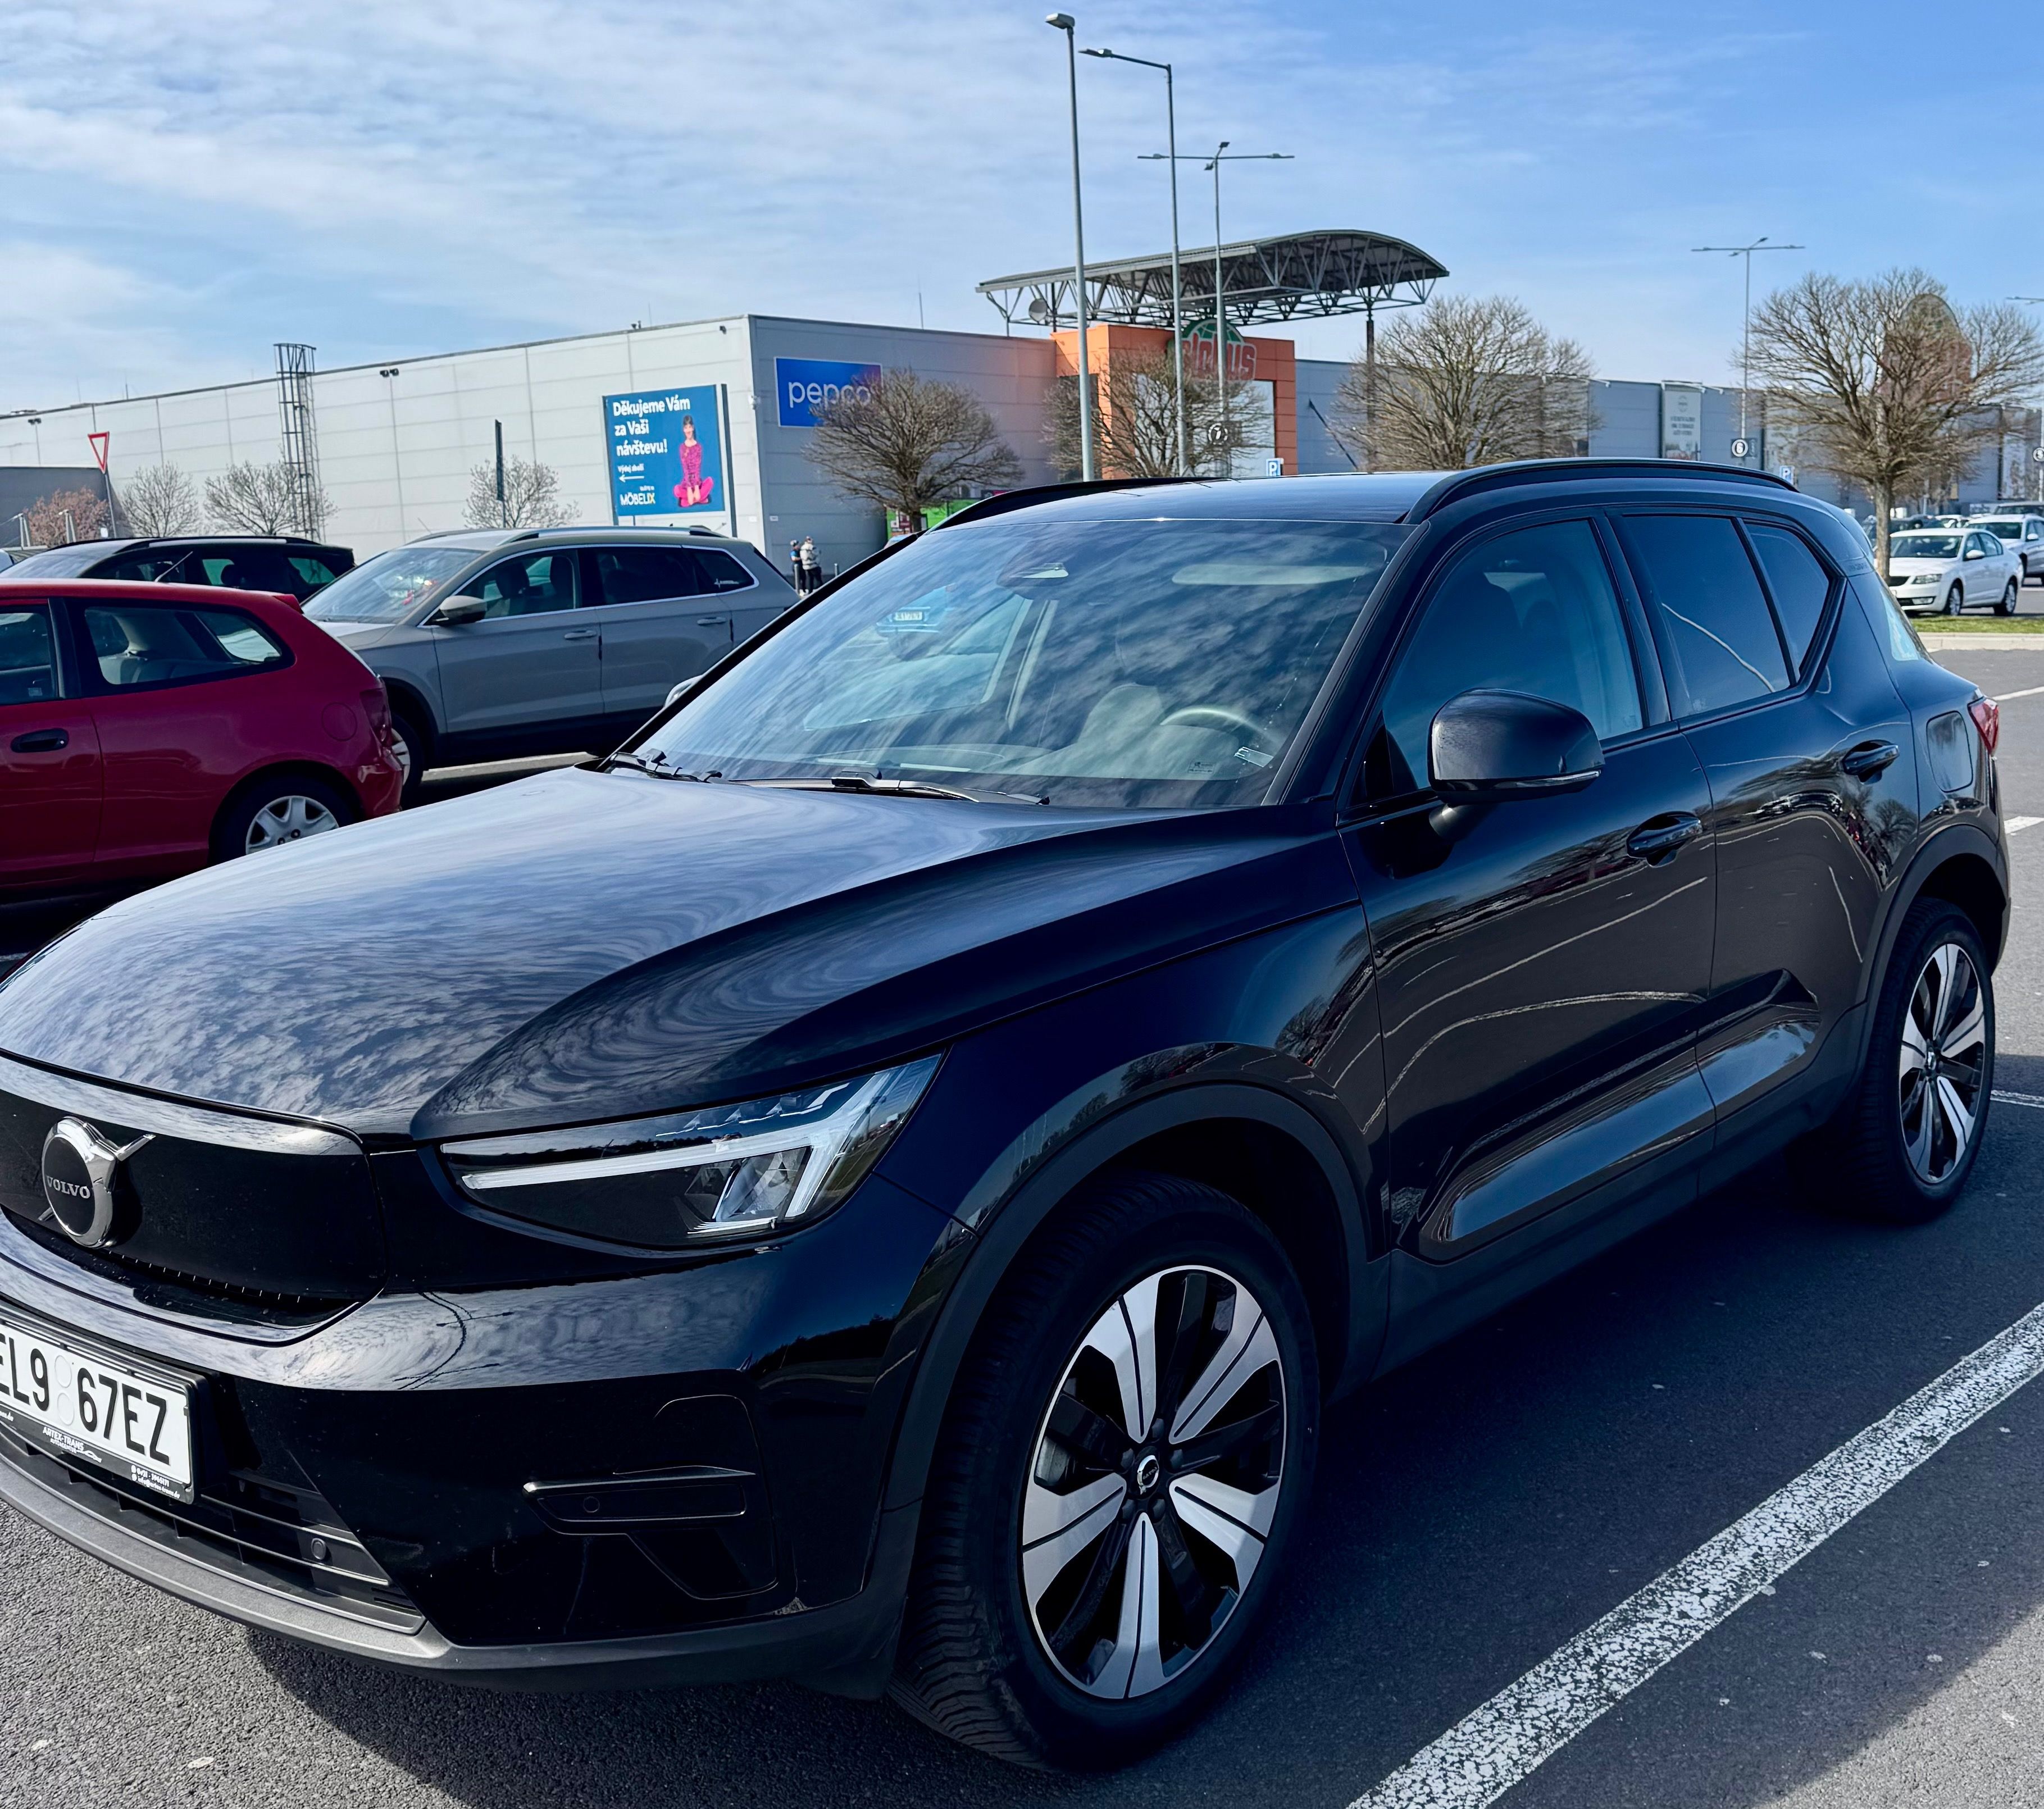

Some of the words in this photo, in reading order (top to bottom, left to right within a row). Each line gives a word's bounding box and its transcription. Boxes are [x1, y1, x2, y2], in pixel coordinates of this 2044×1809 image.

[613, 399, 665, 417] Děkujeme
[665, 394, 690, 411] Vám
[789, 381, 871, 409] pepco
[614, 425, 626, 436] za
[627, 419, 649, 435] Vaši
[1269, 462, 1277, 476] P
[620, 492, 655, 505] MÖBELIX
[46, 1175, 90, 1199] VOLVO
[78, 1368, 171, 1466] 67EZ
